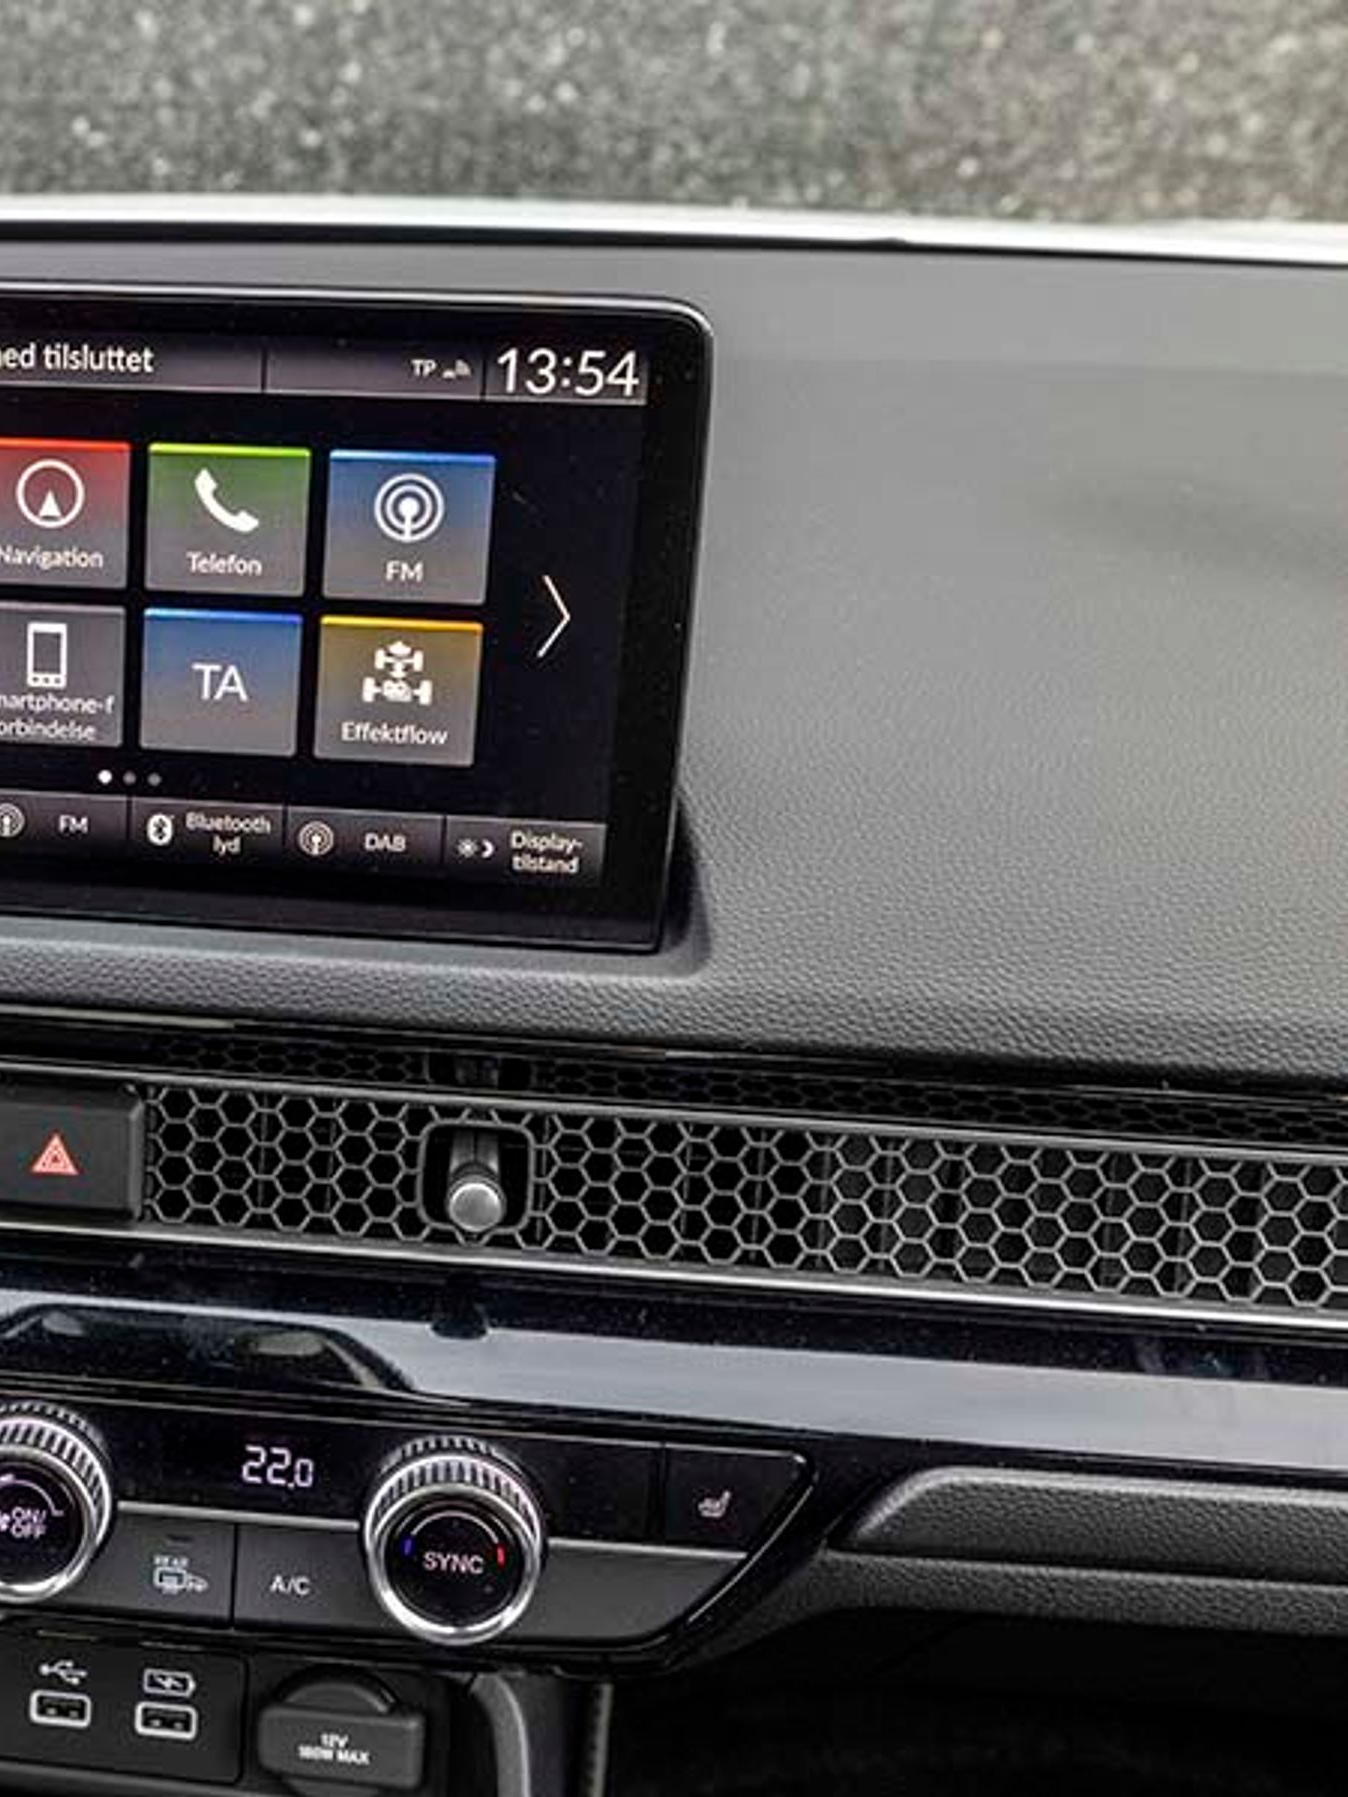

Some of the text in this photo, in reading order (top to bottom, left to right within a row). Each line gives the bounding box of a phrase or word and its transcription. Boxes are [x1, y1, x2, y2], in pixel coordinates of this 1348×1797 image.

[43, 343, 154, 373] tilsluttet
[410, 359, 436, 377] TP
[497, 347, 640, 397] 13:54
[186, 551, 263, 575] Telefon
[385, 560, 425, 583] FM
[190, 661, 249, 703] TA
[340, 720, 449, 746] Effektflow
[58, 813, 89, 835] FM
[185, 811, 272, 835] Bluetooth
[212, 835, 242, 857] lyd
[363, 832, 407, 853] DAB
[509, 829, 583, 856] Display-
[511, 853, 580, 875] tilstand
[240, 1443, 315, 1489] 22.0
[10, 1520, 48, 1540] OFF
[422, 1550, 485, 1576] SYNC
[269, 1575, 312, 1596] A/C
